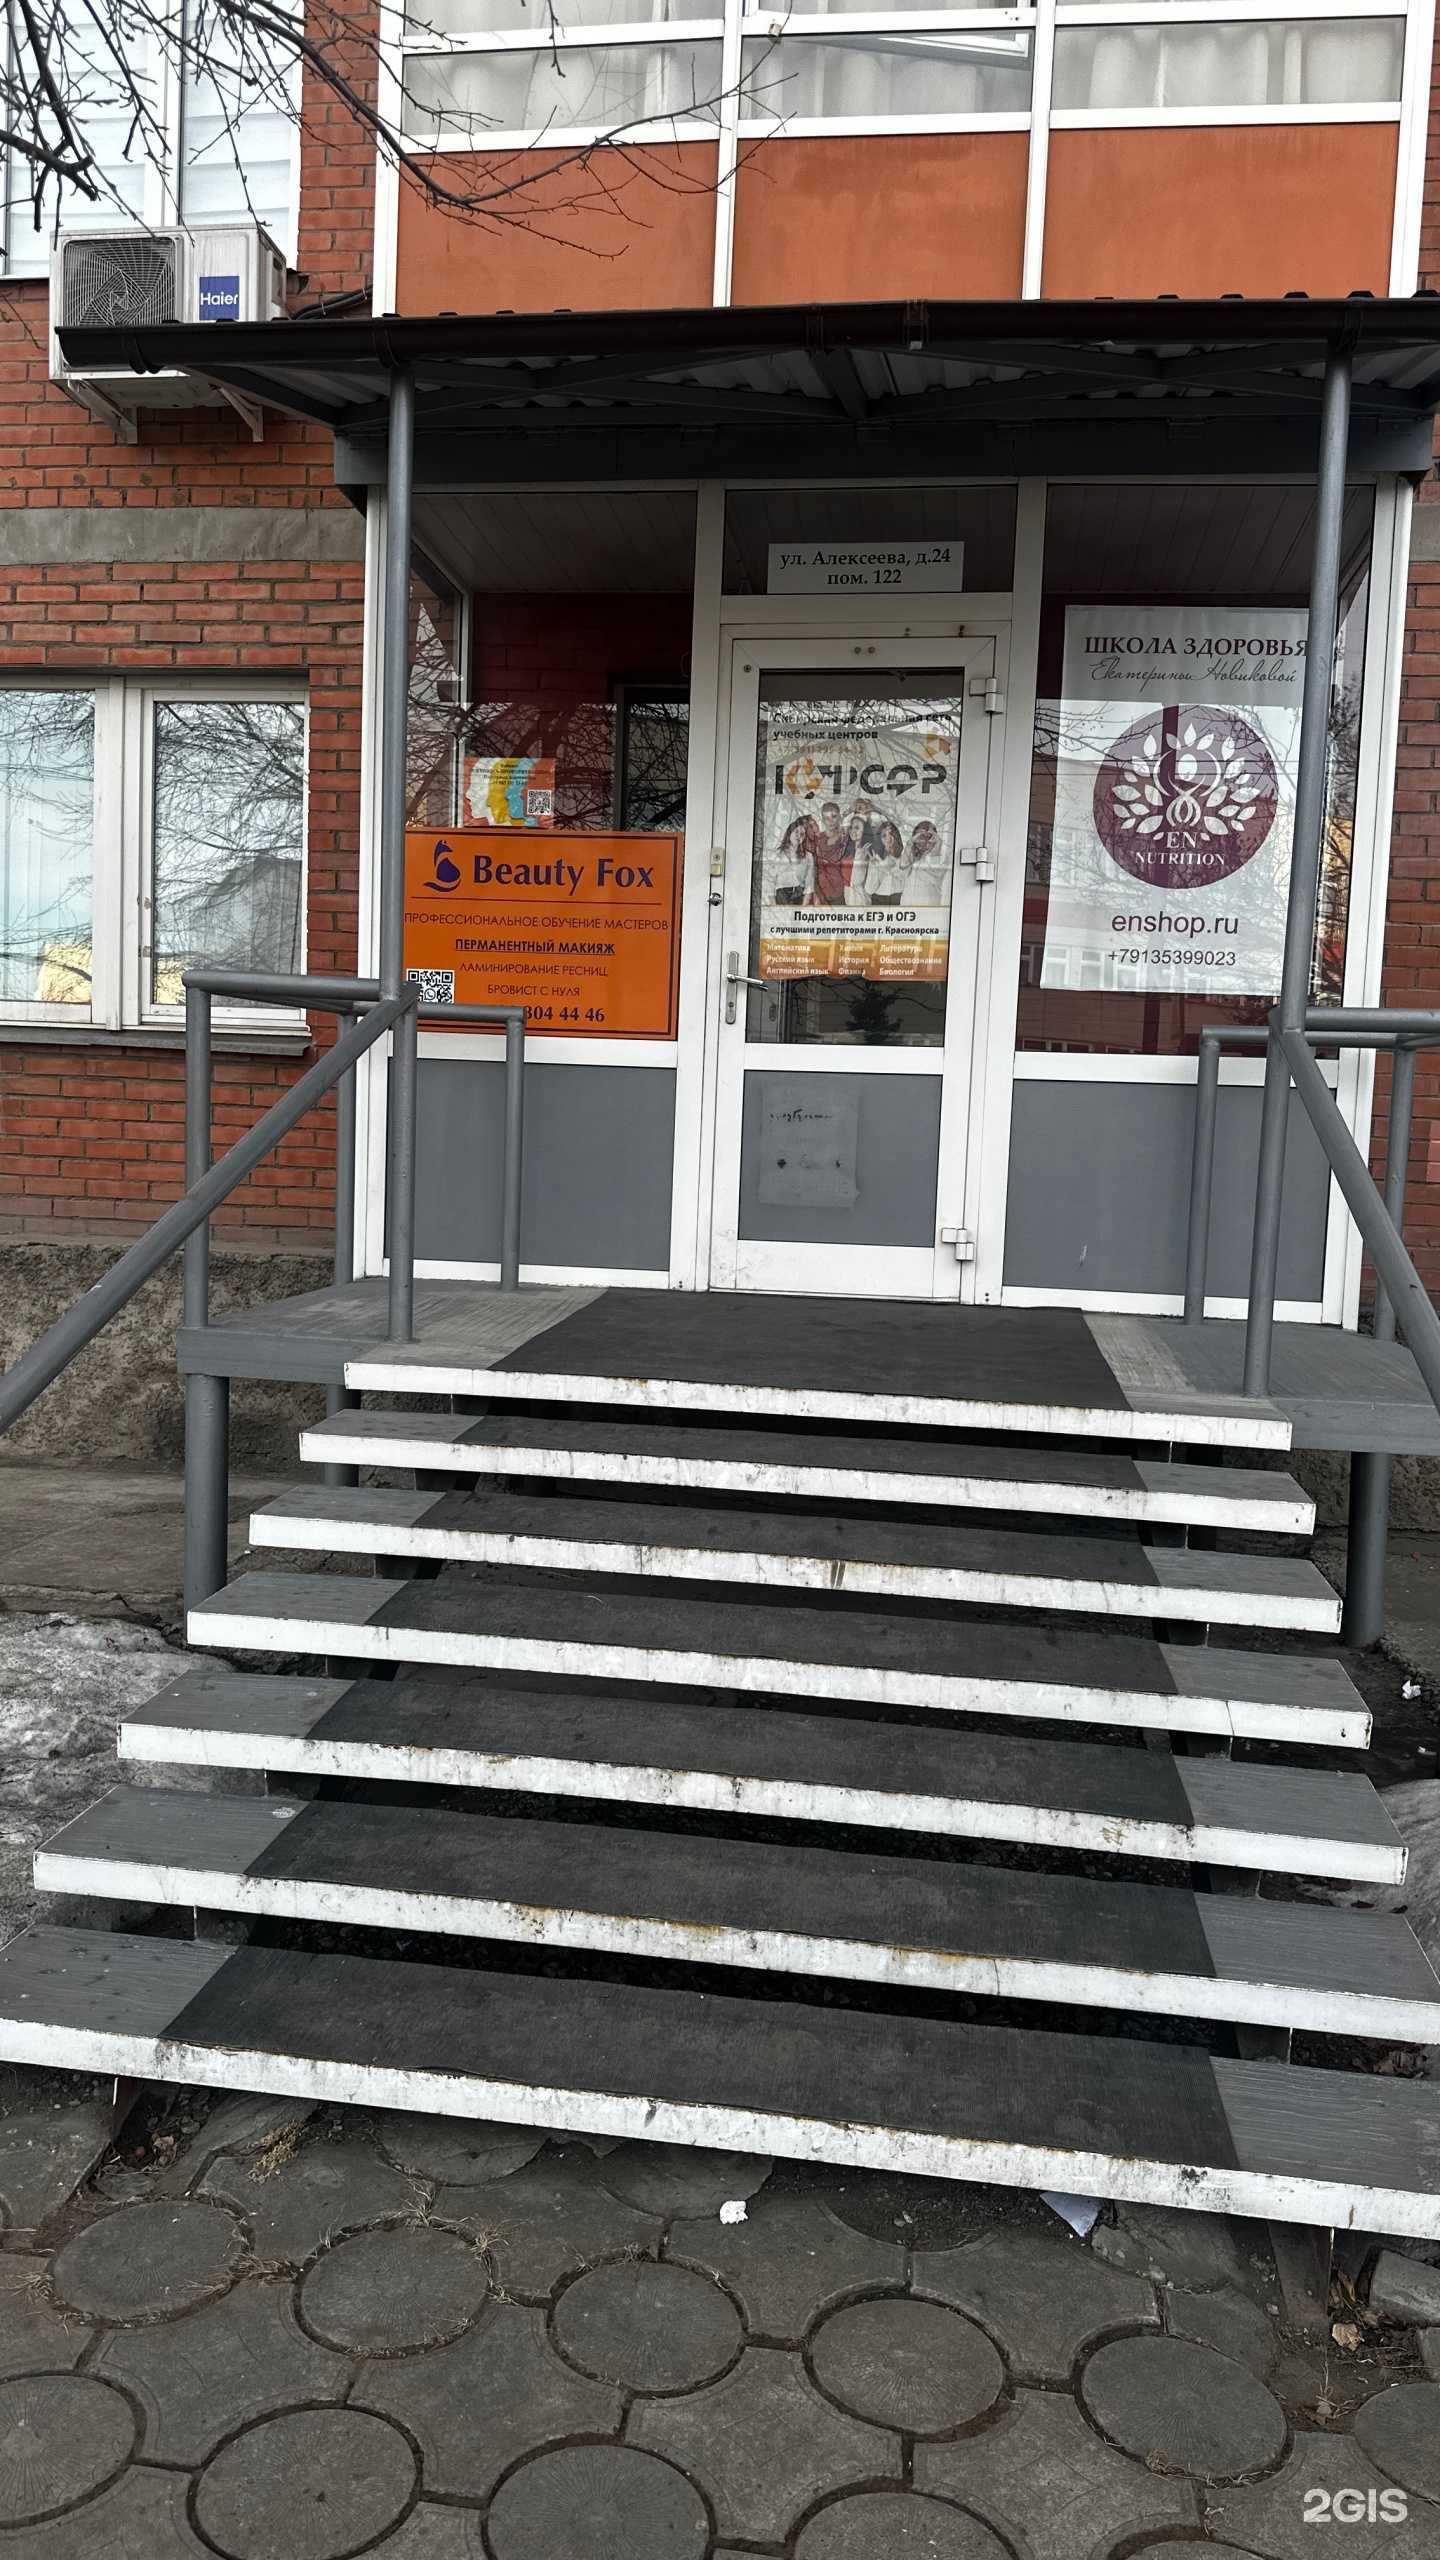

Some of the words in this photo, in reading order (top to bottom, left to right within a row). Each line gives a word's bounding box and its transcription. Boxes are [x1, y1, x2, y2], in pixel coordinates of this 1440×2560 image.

[200, 291, 239, 306] Haier
[780, 554, 807, 570] ул.
[812, 551, 911, 567] Алексеева,
[915, 548, 951, 566] д.24
[827, 573, 868, 585] пом.
[874, 569, 902, 584] 122
[1085, 636, 1177, 655] ШКОЛА
[1183, 637, 1308, 658] ЗДОРОВЬЯ
[1194, 657, 1297, 683] Новиковой
[773, 730, 825, 742] учебных
[828, 731, 878, 742] центров
[1166, 831, 1199, 849] EN
[1135, 851, 1226, 866] NUTRITION
[473, 854, 585, 896] Beauty
[597, 858, 654, 888] Fox
[404, 912, 538, 928] ПРОФЕССИОНАЛЬНОЕ
[541, 917, 601, 929] ОБУЧЕНИЕ
[604, 919, 669, 930] МАСТЕРОВ
[794, 911, 855, 923] Подготовка
[857, 913, 863, 922] к
[866, 911, 884, 922] ЕГЭ
[887, 913, 893, 922] и
[895, 911, 916, 922] ОГЭ
[1111, 911, 1239, 938] enshop.ru
[776, 926, 815, 935] лучшими
[816, 927, 878, 936] репетиторами
[885, 926, 939, 936] Красноярска
[455, 938, 555, 952] ПЕРМАНЕНТНЫЙ
[558, 942, 615, 954] МАКИЯЖ
[1108, 948, 1236, 966] +79135399023
[460, 963, 560, 975] ЛАМИНИРОВАНИЕ
[562, 965, 609, 977] РЕСНИЦ
[487, 984, 537, 996] БРОВИСТ
[540, 986, 548, 996] С
[551, 986, 580, 997] НУЛЯ
[559, 1006, 580, 1021] 44
[585, 1007, 606, 1022] 46
